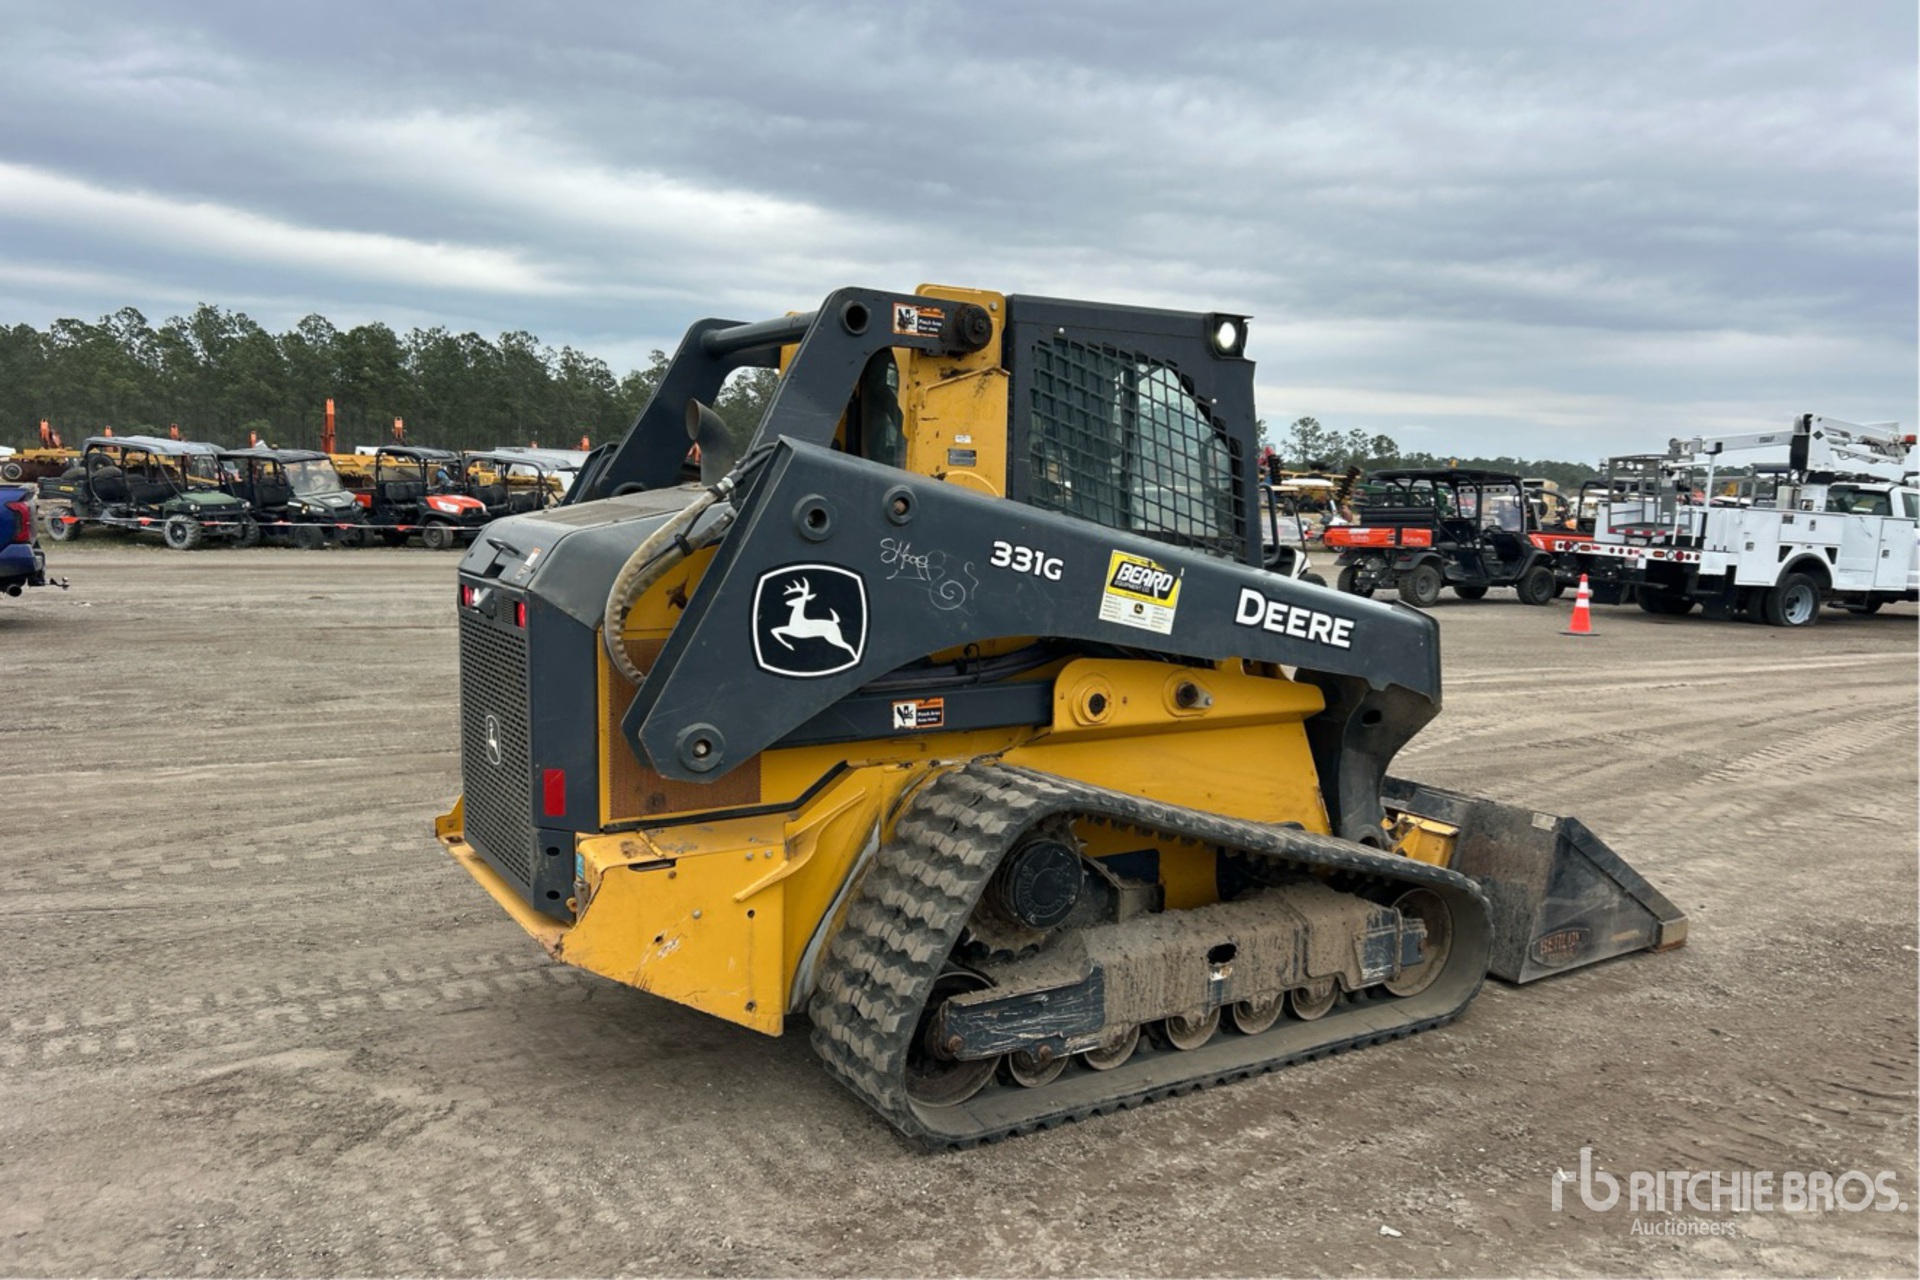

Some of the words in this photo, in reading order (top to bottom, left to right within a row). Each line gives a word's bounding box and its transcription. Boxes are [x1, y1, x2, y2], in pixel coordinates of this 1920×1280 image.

[990, 541, 1064, 581] 331G
[1116, 562, 1174, 598] BEARD
[1235, 587, 1355, 649] DEERE
